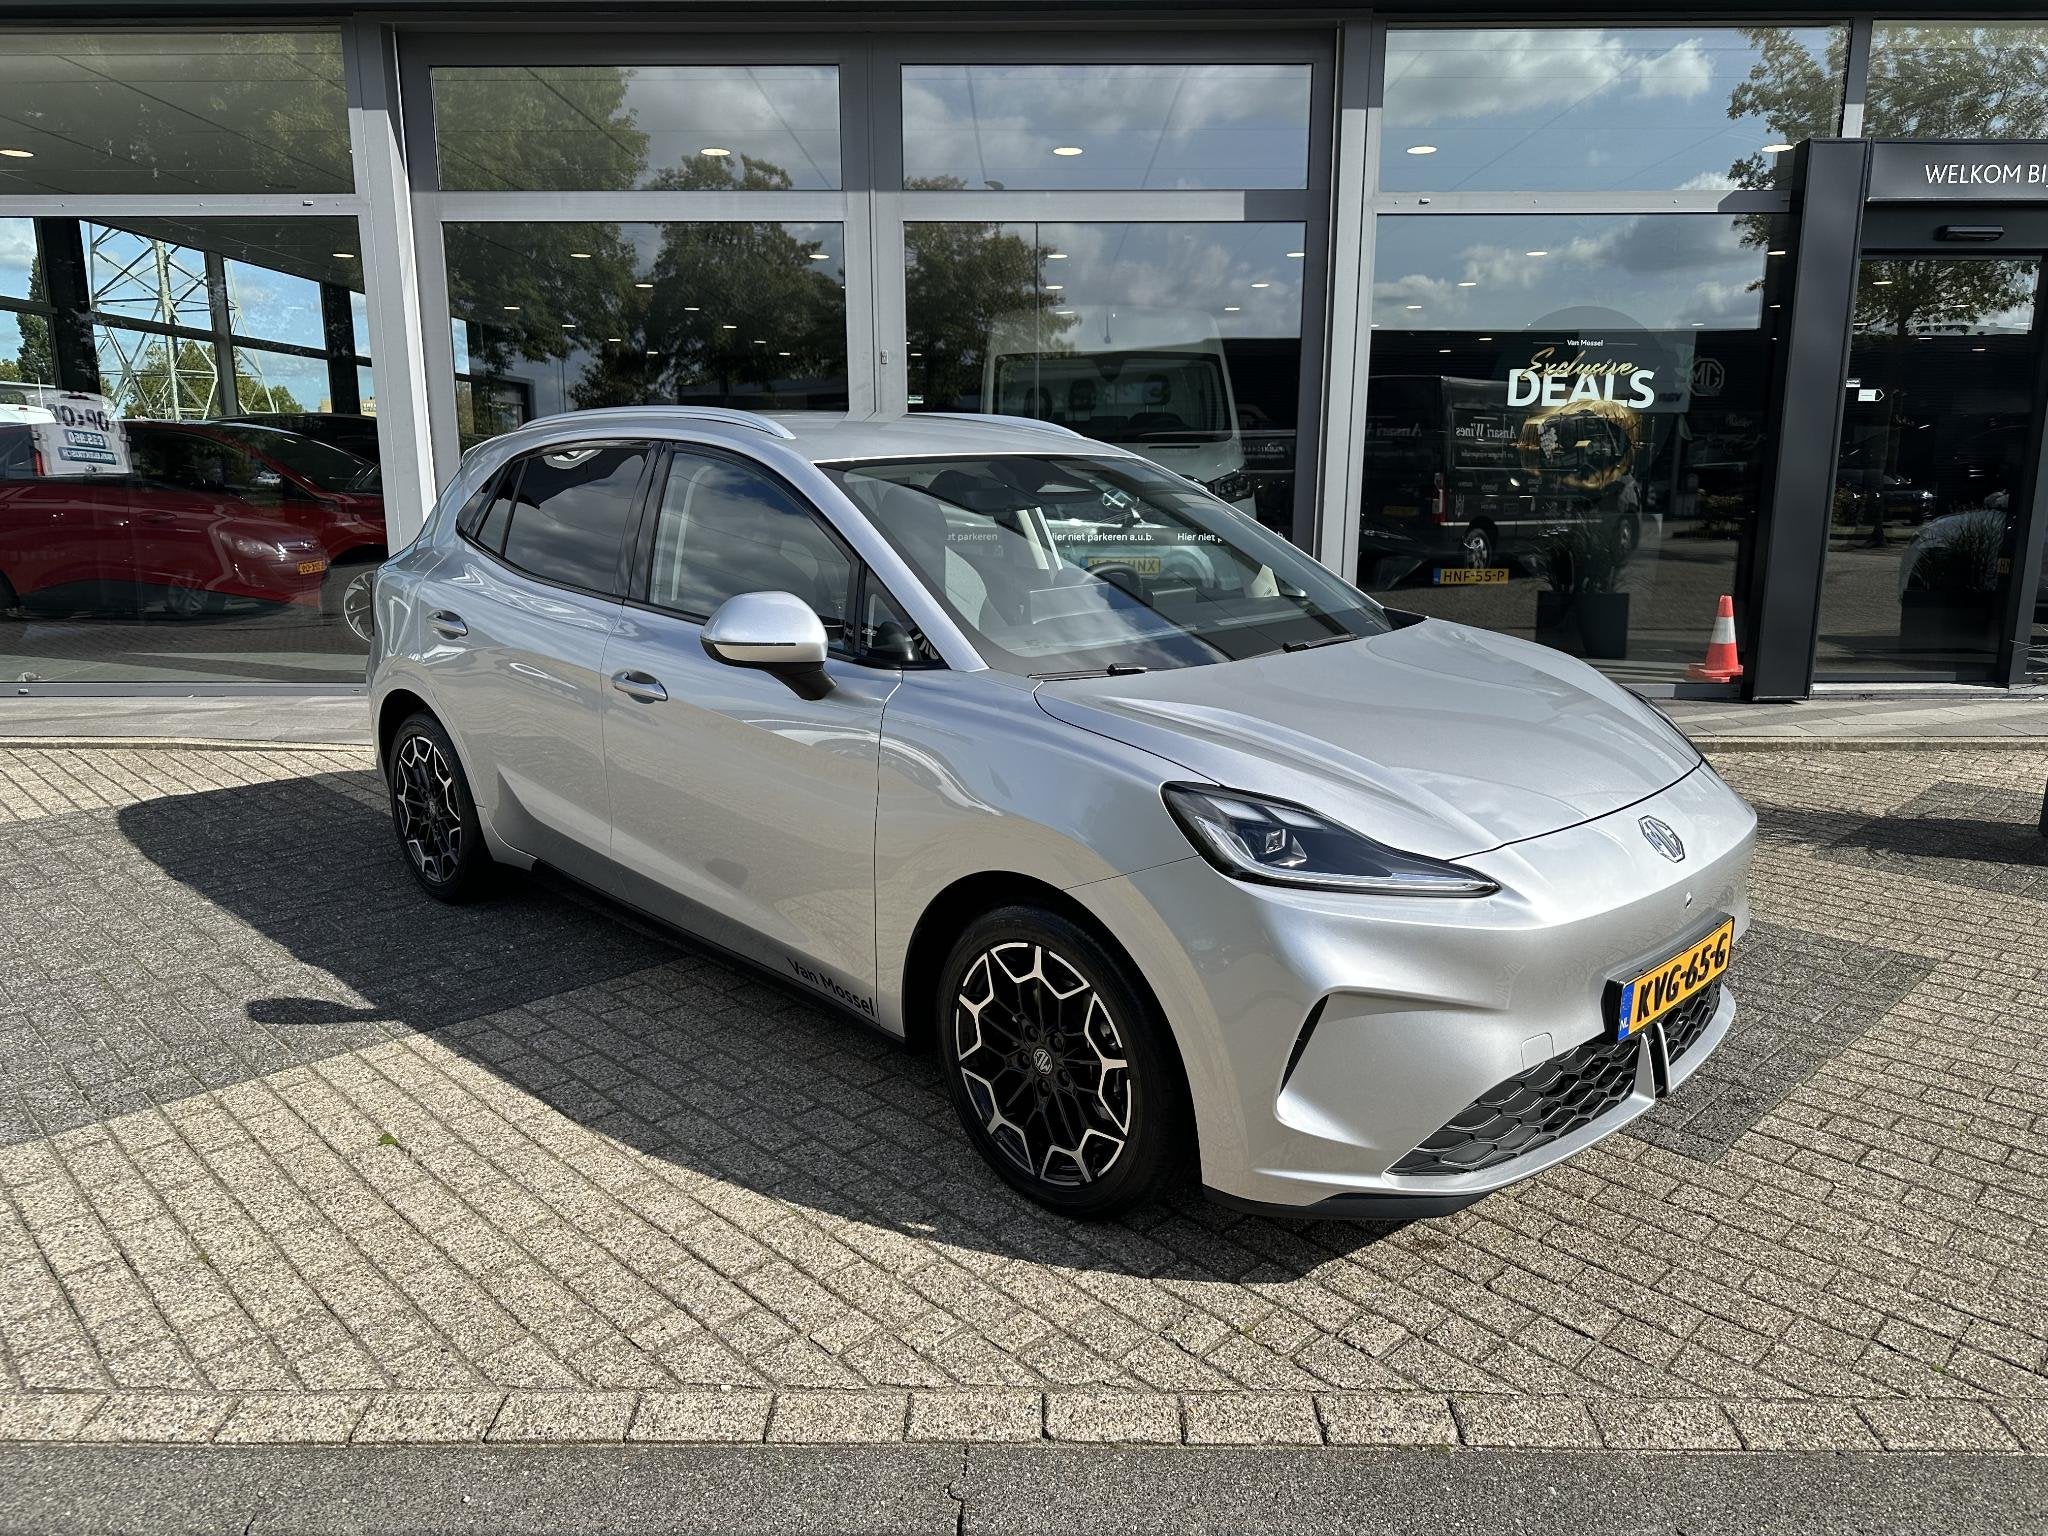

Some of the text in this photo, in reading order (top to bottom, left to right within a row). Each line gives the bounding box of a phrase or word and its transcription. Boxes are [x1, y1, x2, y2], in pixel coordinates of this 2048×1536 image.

[1925, 164, 2048, 188] WELKOM BI
[1567, 339, 1604, 347] Van Mossel
[1519, 346, 1639, 382] Exclusive
[1507, 369, 1655, 409] DEALS
[958, 532, 998, 543] parkeren
[1068, 533, 1085, 541] niet
[1087, 533, 1128, 542] parkeren
[1130, 533, 1154, 541] a.u.b.
[1177, 533, 1196, 541] Hier
[1198, 533, 1215, 541] niet
[1443, 570, 1506, 582] HNF-55-P
[1636, 931, 1729, 1023] KVG-65-G
[786, 956, 875, 1017] Van Mossel
